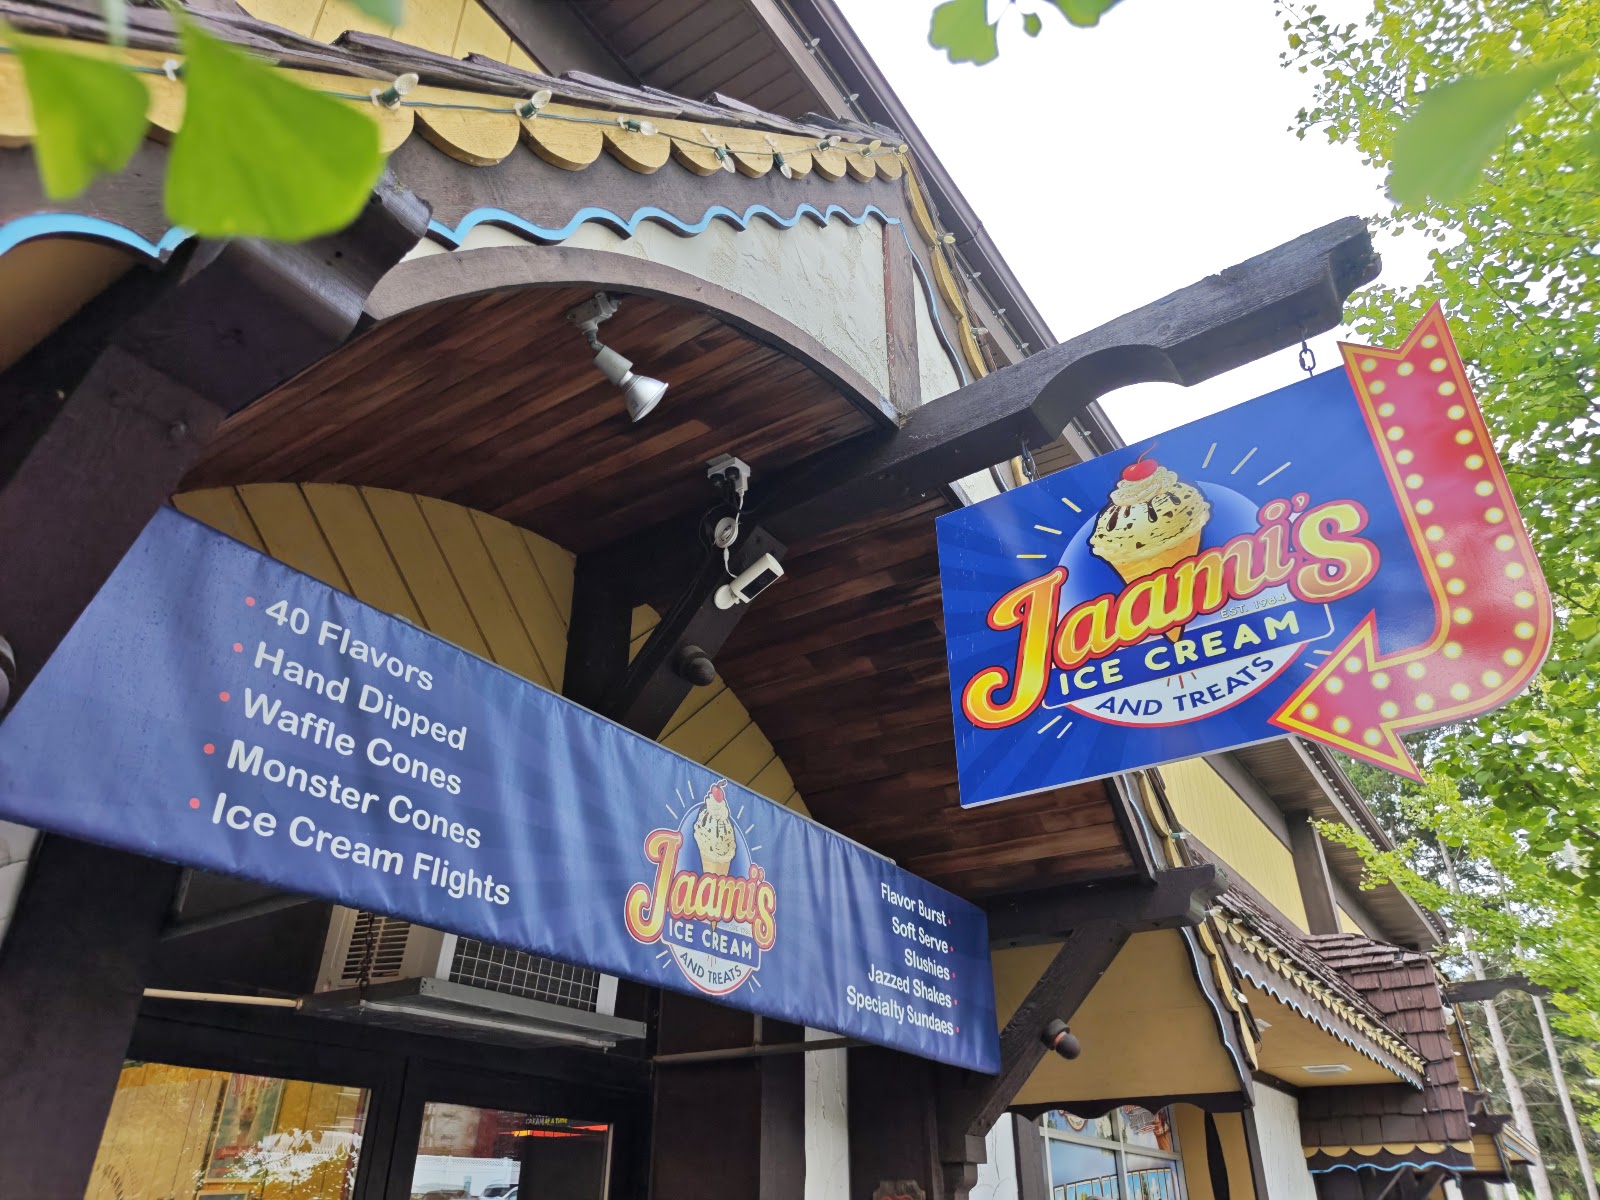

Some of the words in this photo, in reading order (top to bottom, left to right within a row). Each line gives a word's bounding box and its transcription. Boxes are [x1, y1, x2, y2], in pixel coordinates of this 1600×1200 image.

[265, 600, 309, 634] 40
[318, 620, 433, 690] Flavors
[1058, 660, 1124, 696] ICE
[1144, 609, 1299, 671] CREAM
[254, 641, 349, 703] Hand
[358, 684, 467, 750] Dipped
[1095, 694, 1163, 717] AND
[1172, 655, 1274, 712] TREATS
[244, 687, 355, 755] Waffle
[366, 737, 461, 794] Cones
[227, 739, 379, 814] Monster
[388, 795, 481, 848] Cones
[211, 792, 277, 836] Ice
[289, 816, 403, 875] Cream
[413, 851, 510, 905] Flights
[881, 882, 916, 912] Flavor
[918, 899, 947, 927] Burst
[669, 919, 694, 943] ICE
[702, 929, 752, 960] CREAM
[892, 916, 917, 941] Soft
[918, 926, 948, 954] Serve
[680, 951, 705, 978] AND
[708, 965, 742, 985] TREATS
[868, 963, 910, 994] Jazzed
[912, 979, 952, 1008] Shakes
[904, 948, 950, 981] Slushies
[846, 985, 905, 1025] Specialty
[906, 1005, 954, 1036] Sundaes
